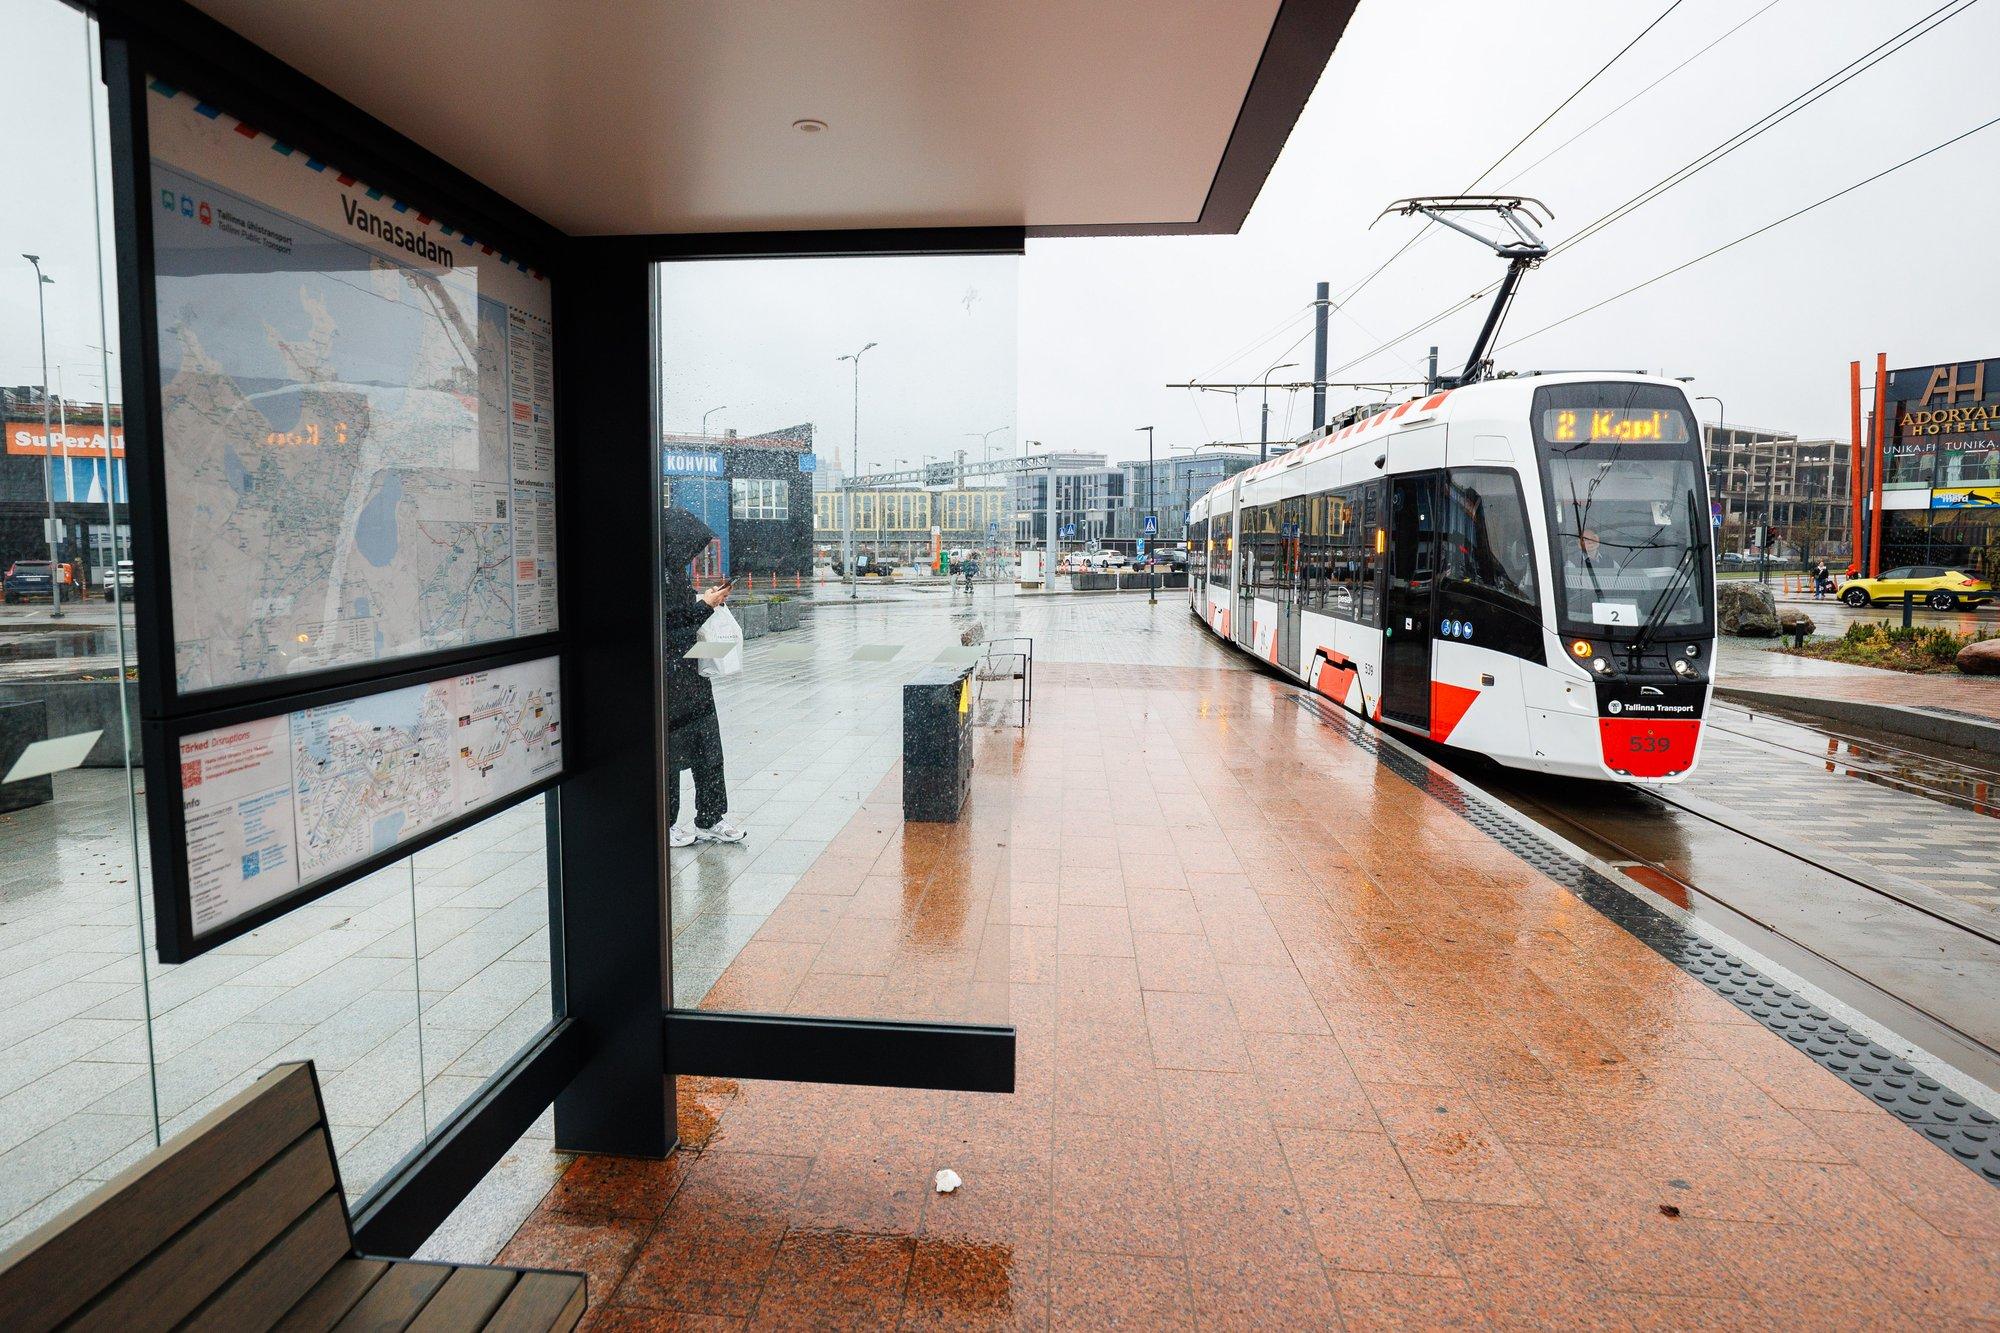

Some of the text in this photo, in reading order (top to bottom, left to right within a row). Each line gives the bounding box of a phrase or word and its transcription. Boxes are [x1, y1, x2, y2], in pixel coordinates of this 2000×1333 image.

[217, 208, 245, 227] Tallinna
[341, 193, 453, 269] Vanasadam
[1919, 362, 1985, 407] AH
[1557, 410, 1576, 440] 2
[1912, 420, 1991, 436] HOTELL
[667, 455, 718, 473] KOHVIK
[1610, 611, 1620, 622] 2
[1364, 662, 1374, 676] 539
[1624, 703, 1694, 714] Tallinna Transport
[211, 730, 251, 748] Disruptions
[1629, 735, 1671, 753] 539
